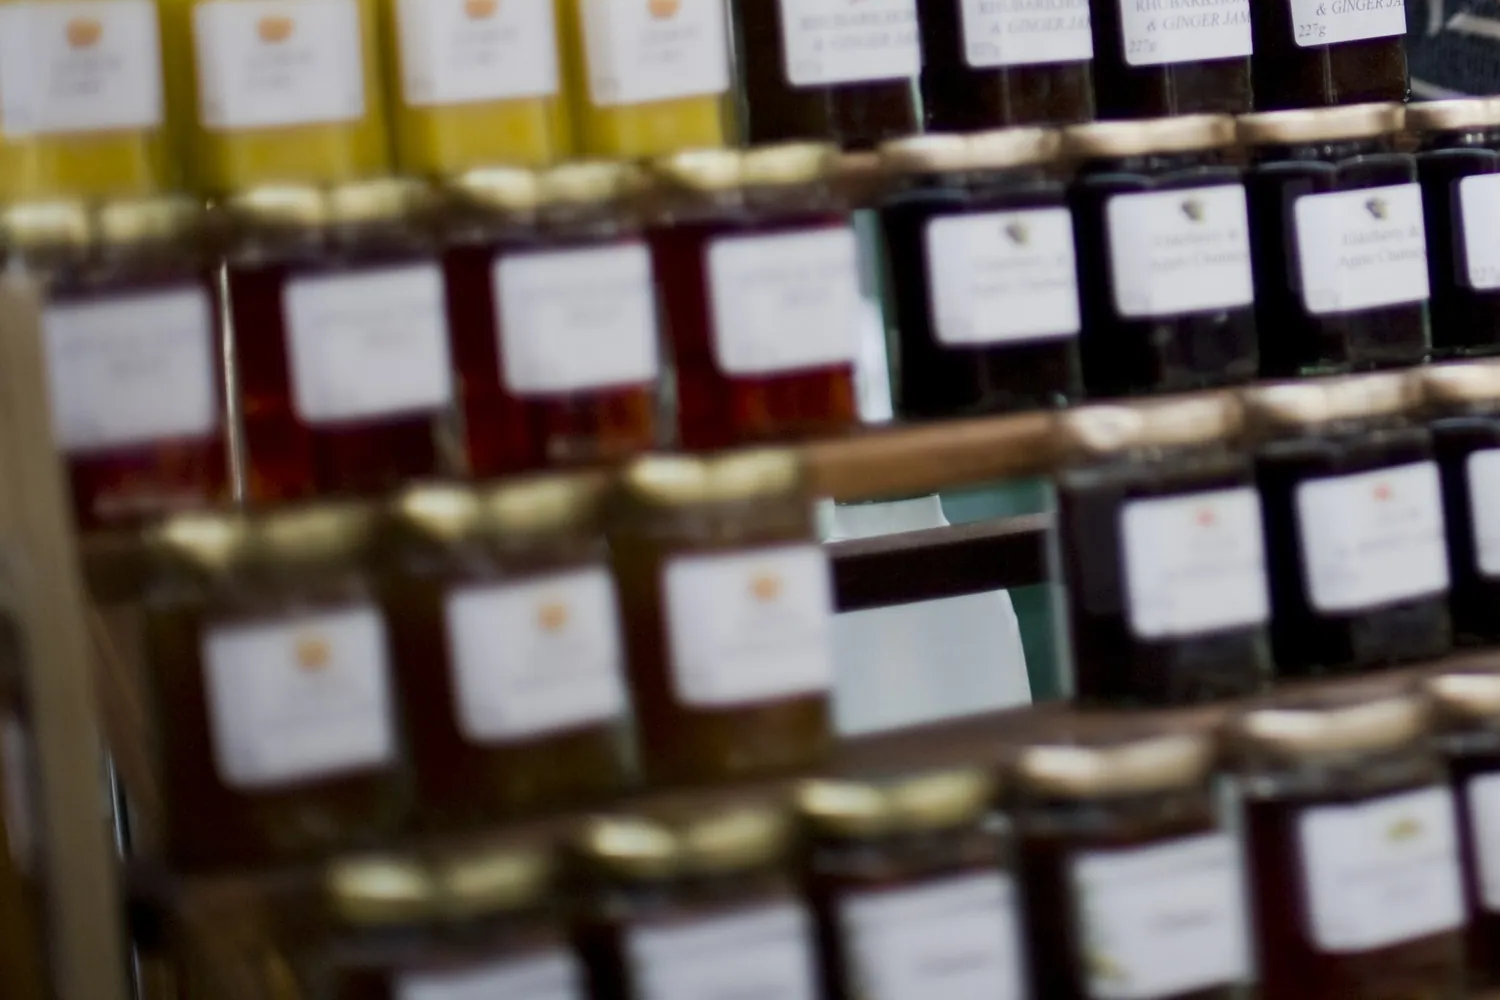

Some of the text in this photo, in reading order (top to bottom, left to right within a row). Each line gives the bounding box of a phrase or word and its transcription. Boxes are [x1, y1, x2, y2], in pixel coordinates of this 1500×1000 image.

[1316, 3, 1327, 16] &
[1146, 20, 1157, 32] &
[1162, 13, 1220, 30] GINGER
[1298, 23, 1327, 38] 227g
